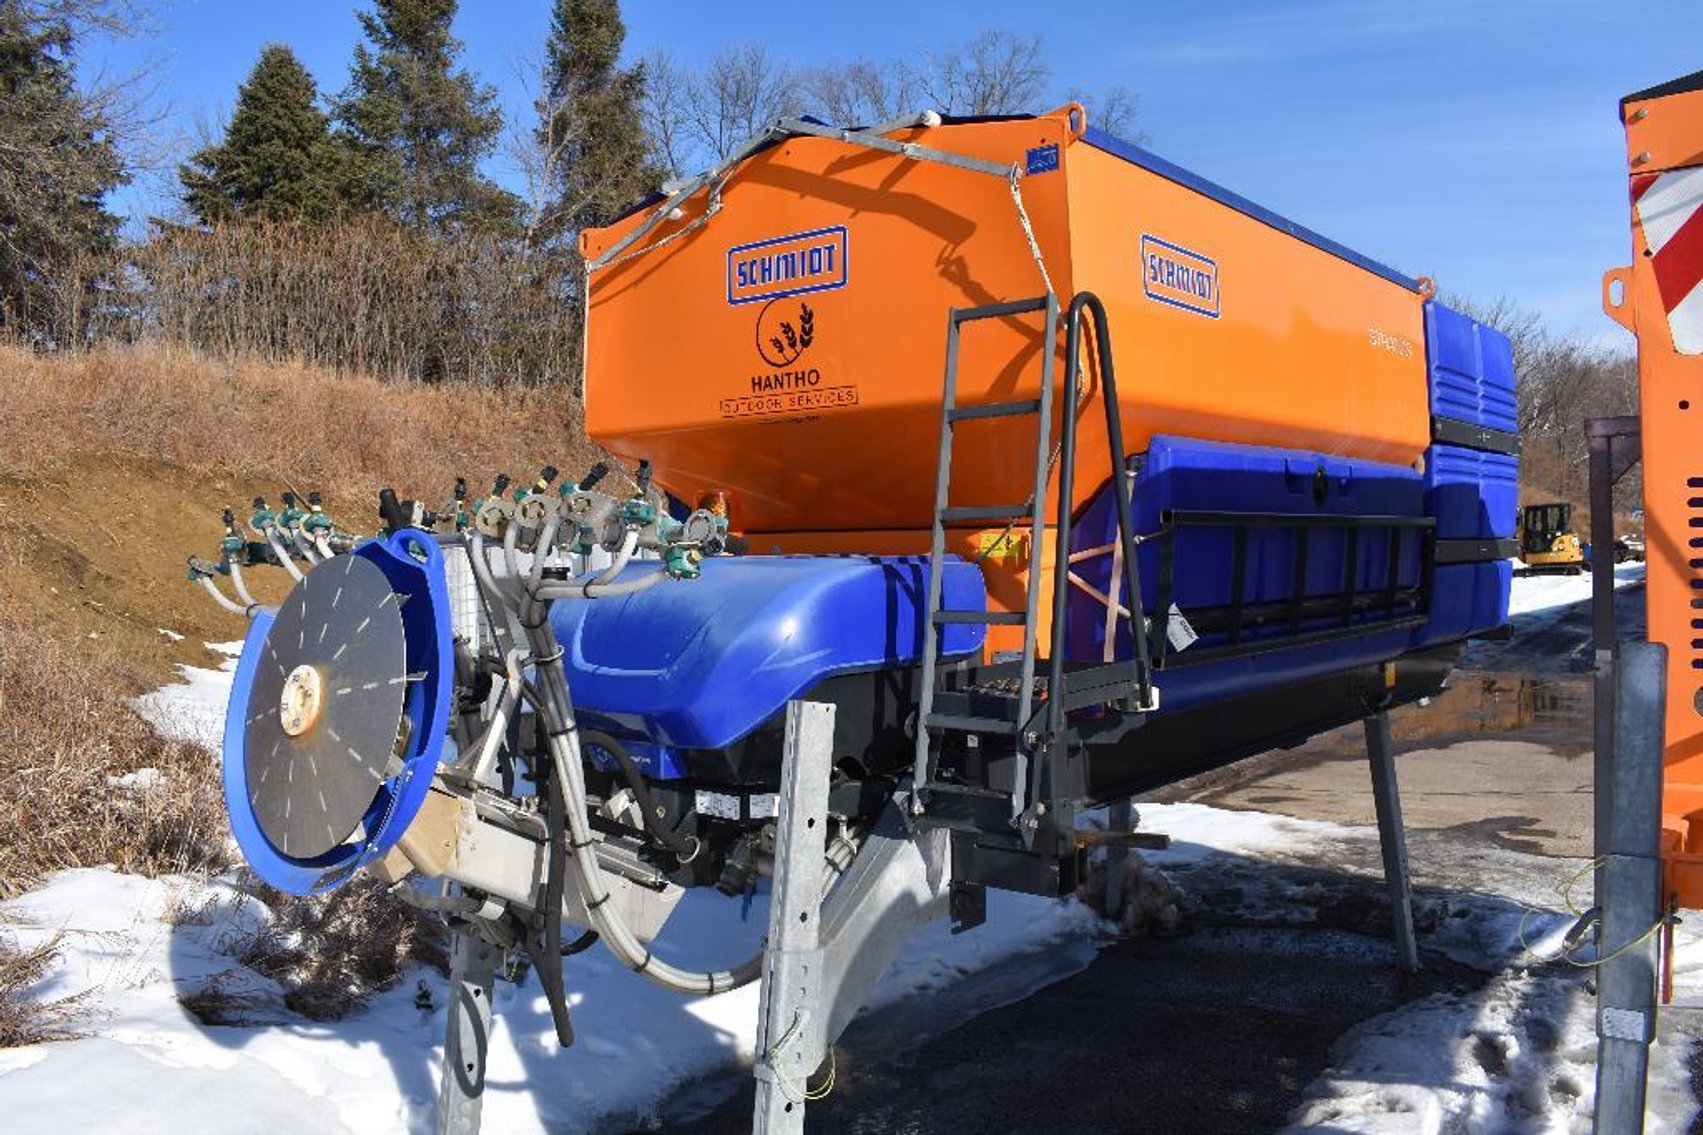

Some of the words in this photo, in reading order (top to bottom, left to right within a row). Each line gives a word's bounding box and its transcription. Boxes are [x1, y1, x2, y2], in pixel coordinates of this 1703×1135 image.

[736, 244, 837, 288] SCHMIDT
[1149, 254, 1213, 300] SCHMIDT
[751, 369, 820, 393] HANTHO
[723, 399, 783, 415] OUTDOOR
[788, 390, 855, 407] SERVICES
